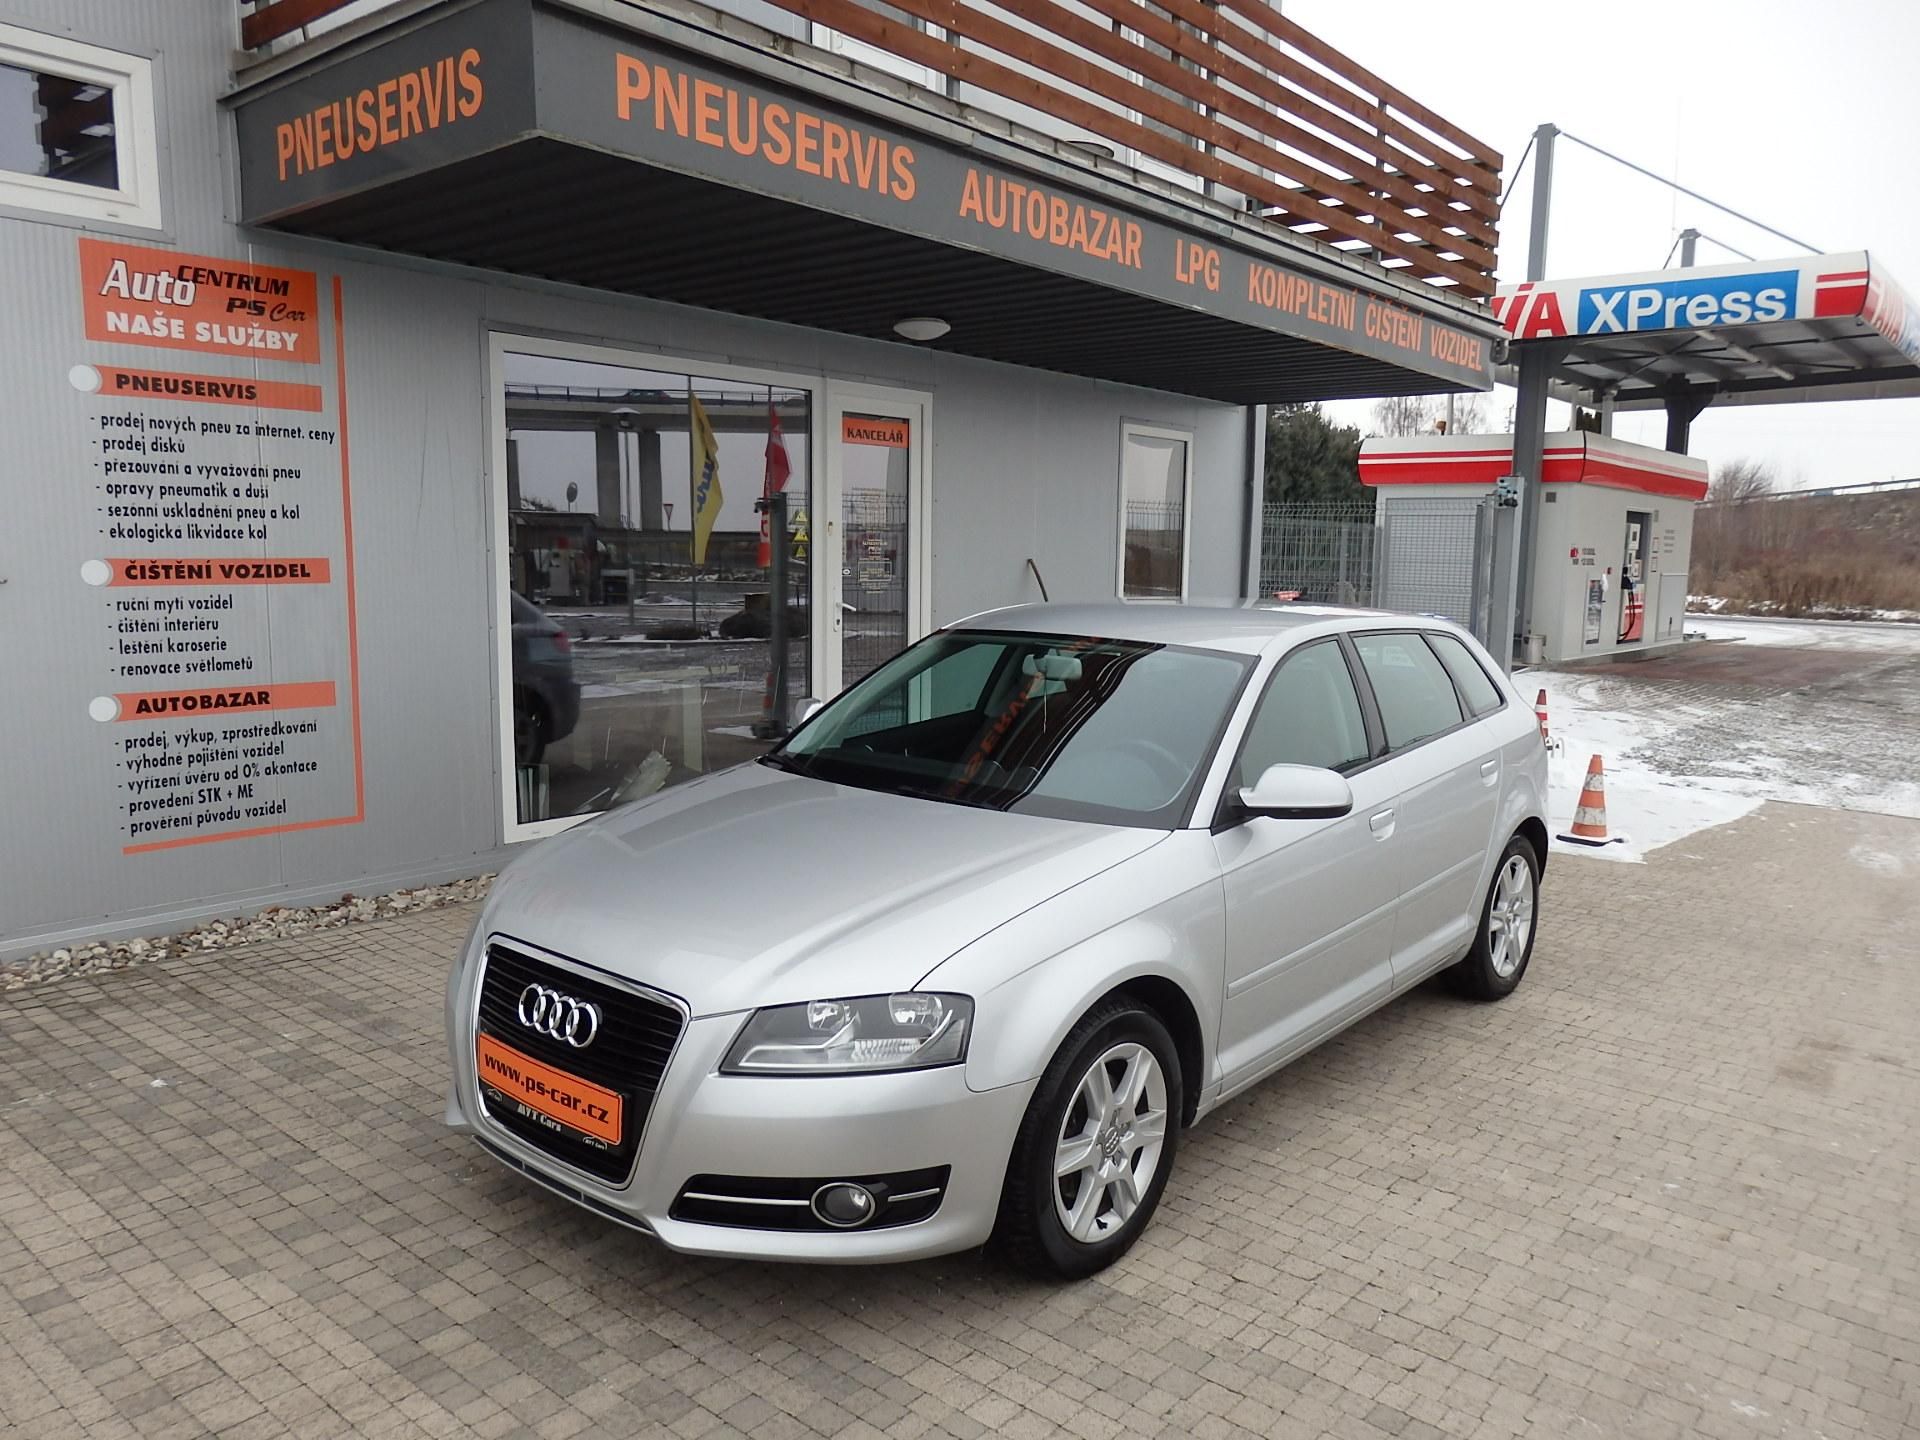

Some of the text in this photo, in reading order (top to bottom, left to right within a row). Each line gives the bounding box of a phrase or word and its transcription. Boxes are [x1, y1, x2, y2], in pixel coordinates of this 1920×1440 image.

[276, 47, 485, 182] PNEUSERVIS
[615, 52, 1483, 372] PNEUSERVIS AUTOBAZAR LPG KOMPLETNÍ ČIŠTĚNÍ VOZIDEL
[99, 258, 290, 307] Auto CENTRUM
[226, 297, 267, 316] PS
[1587, 287, 1787, 334] XPress
[106, 310, 299, 352] NAŠE SLUŽBY
[116, 373, 257, 400] PNEUSERVIS
[101, 412, 335, 444] prodej nových pneu za internet. ceny
[103, 436, 146, 455] prodej
[105, 459, 301, 482] přezouvání a vyvažování pneu
[106, 484, 154, 499] opravy
[160, 482, 228, 500] pneumatik
[233, 488, 240, 498] a
[163, 503, 232, 519] uskladnění
[237, 507, 266, 522] pneu
[270, 510, 277, 520] a
[282, 504, 300, 520] kol
[109, 523, 267, 543] ekologická likvidace kol
[125, 560, 311, 581] ČIŠTĚNÍ VOZIDEL
[116, 597, 149, 611] ruční
[188, 594, 233, 610] vozidel
[118, 616, 219, 633] čištění interiéru
[119, 637, 227, 655] leštění karoserie
[121, 656, 253, 676] renovace světlometů
[135, 691, 270, 714] AUTOBAZAR
[125, 719, 317, 753] prodej, výkup, zprostředkování
[188, 747, 238, 768] pojištění
[243, 740, 284, 758] vozidel
[224, 765, 239, 781] od
[243, 763, 260, 778] 0%
[264, 759, 317, 776] akontace
[129, 793, 194, 816] provedení
[198, 787, 222, 804] STK
[237, 783, 253, 799] ME
[197, 806, 241, 828] původu
[245, 799, 287, 818] vozidel
[484, 1053, 609, 1124] www.ps-car.cz
